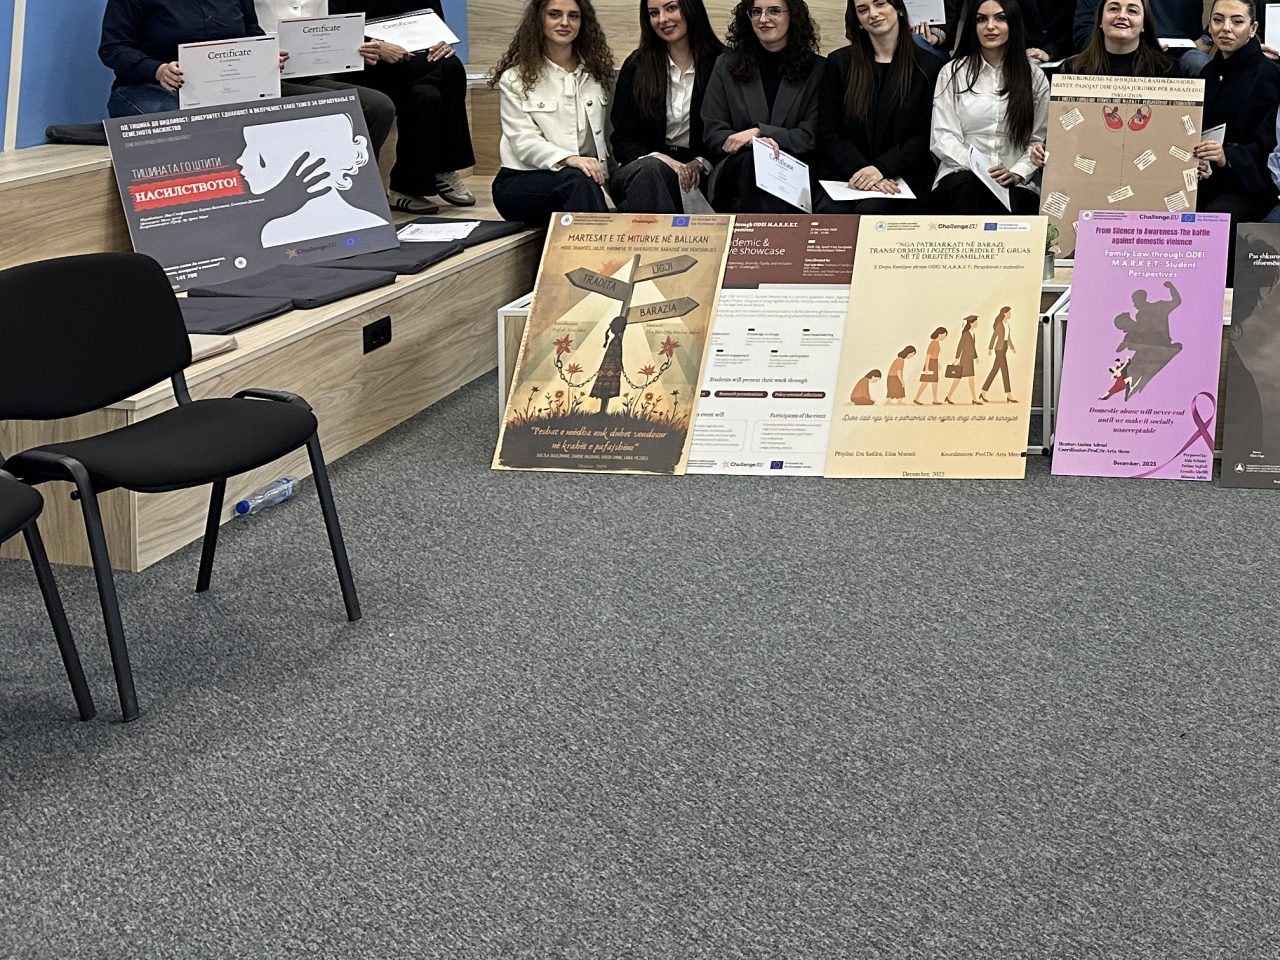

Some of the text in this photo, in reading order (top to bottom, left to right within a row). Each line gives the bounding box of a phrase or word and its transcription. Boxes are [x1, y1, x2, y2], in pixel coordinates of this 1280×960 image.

[303, 24, 340, 34] Certificate
[383, 20, 418, 29] Certificate
[208, 49, 251, 60] Certificate
[135, 177, 238, 203] НАСИЛСТВОТО!
[569, 234, 608, 242] MARTESAT
[618, 232, 627, 242] TË
[628, 235, 659, 243] MITURVE
[662, 233, 672, 243] NË
[675, 235, 709, 244] BALLKAN
[763, 238, 770, 247] &
[1111, 237, 1135, 245] against
[740, 247, 785, 255] showcase
[1104, 250, 1130, 258] Family
[1152, 251, 1183, 260] through
[652, 262, 673, 274] LIGJI
[1128, 270, 1177, 278] Perspectives
[583, 273, 617, 291] TRADITA
[639, 304, 677, 316] BARAZIA
[1150, 418, 1174, 426] socially
